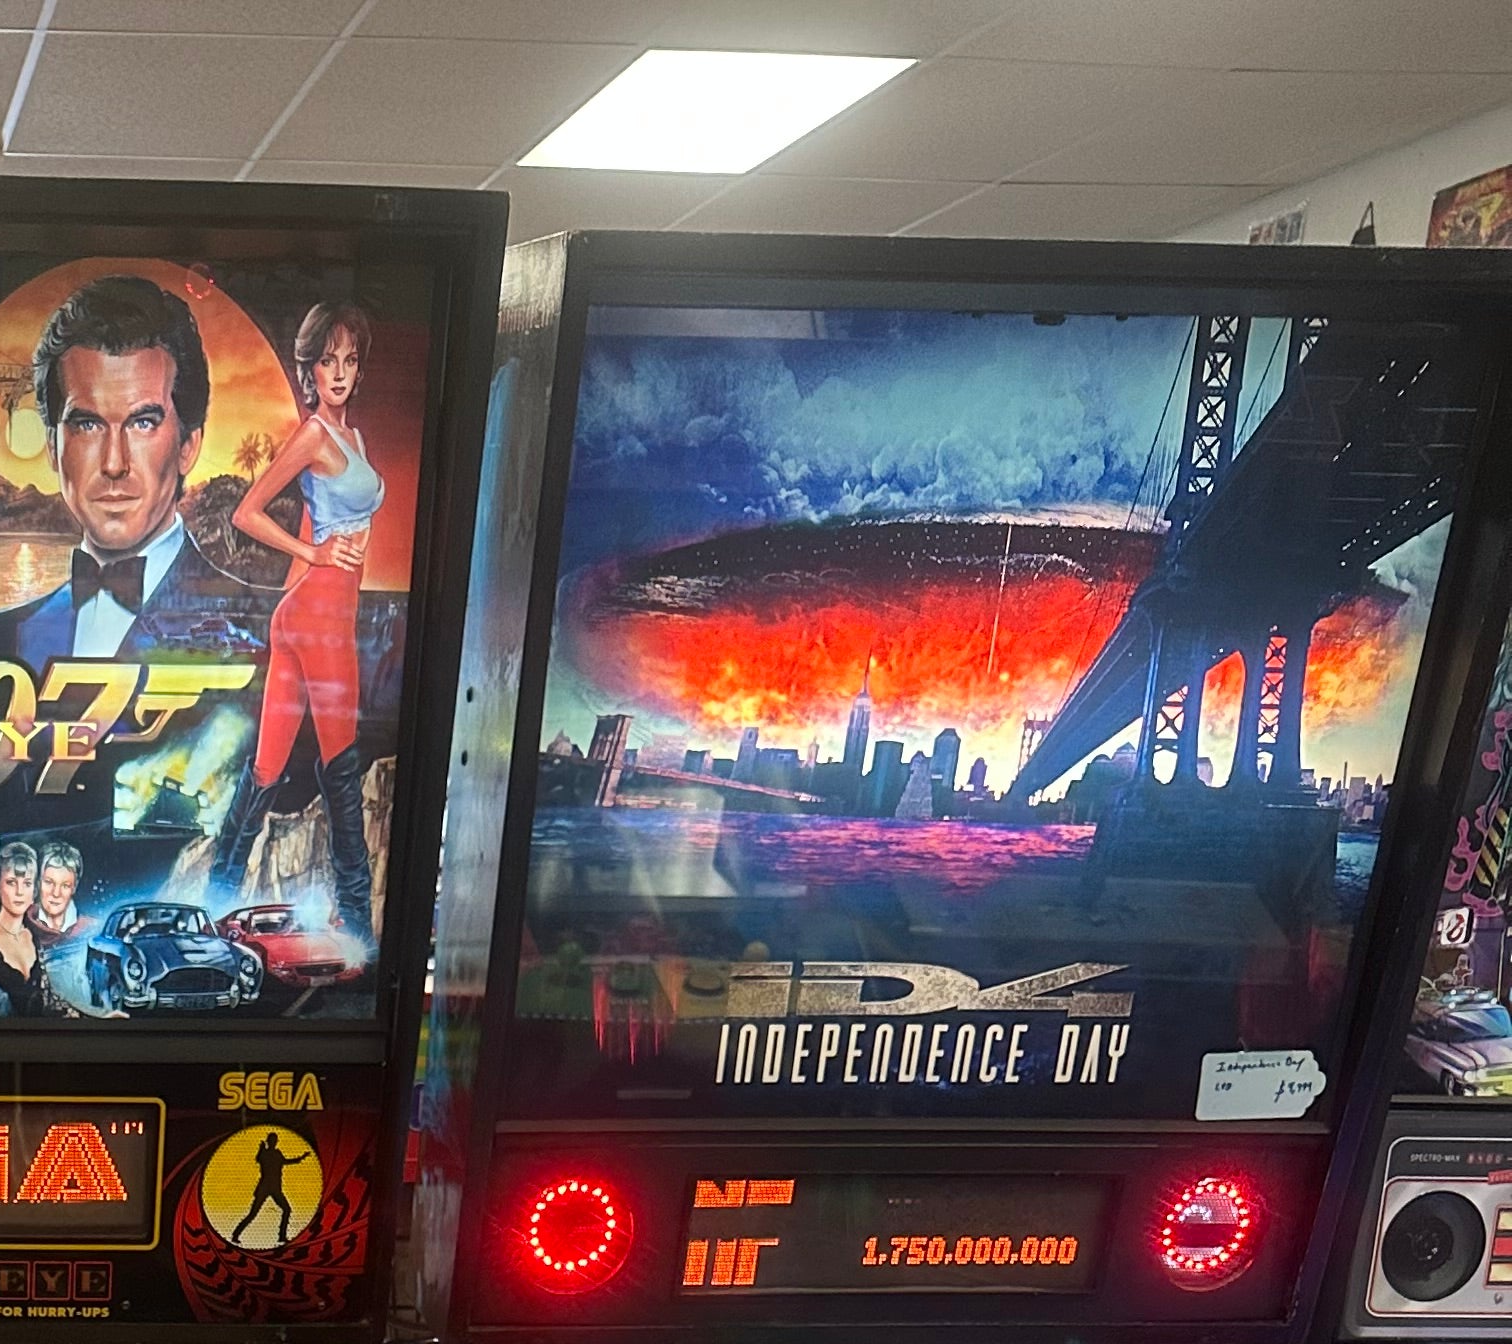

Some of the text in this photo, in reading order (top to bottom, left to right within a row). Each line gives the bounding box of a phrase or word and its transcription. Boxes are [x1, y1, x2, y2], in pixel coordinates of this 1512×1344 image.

[715, 1023, 1130, 1084] INDEPENDENCE DAY
[218, 1071, 324, 1111] SEGA
[27, 1305, 110, 1319] HURRY-UPS
